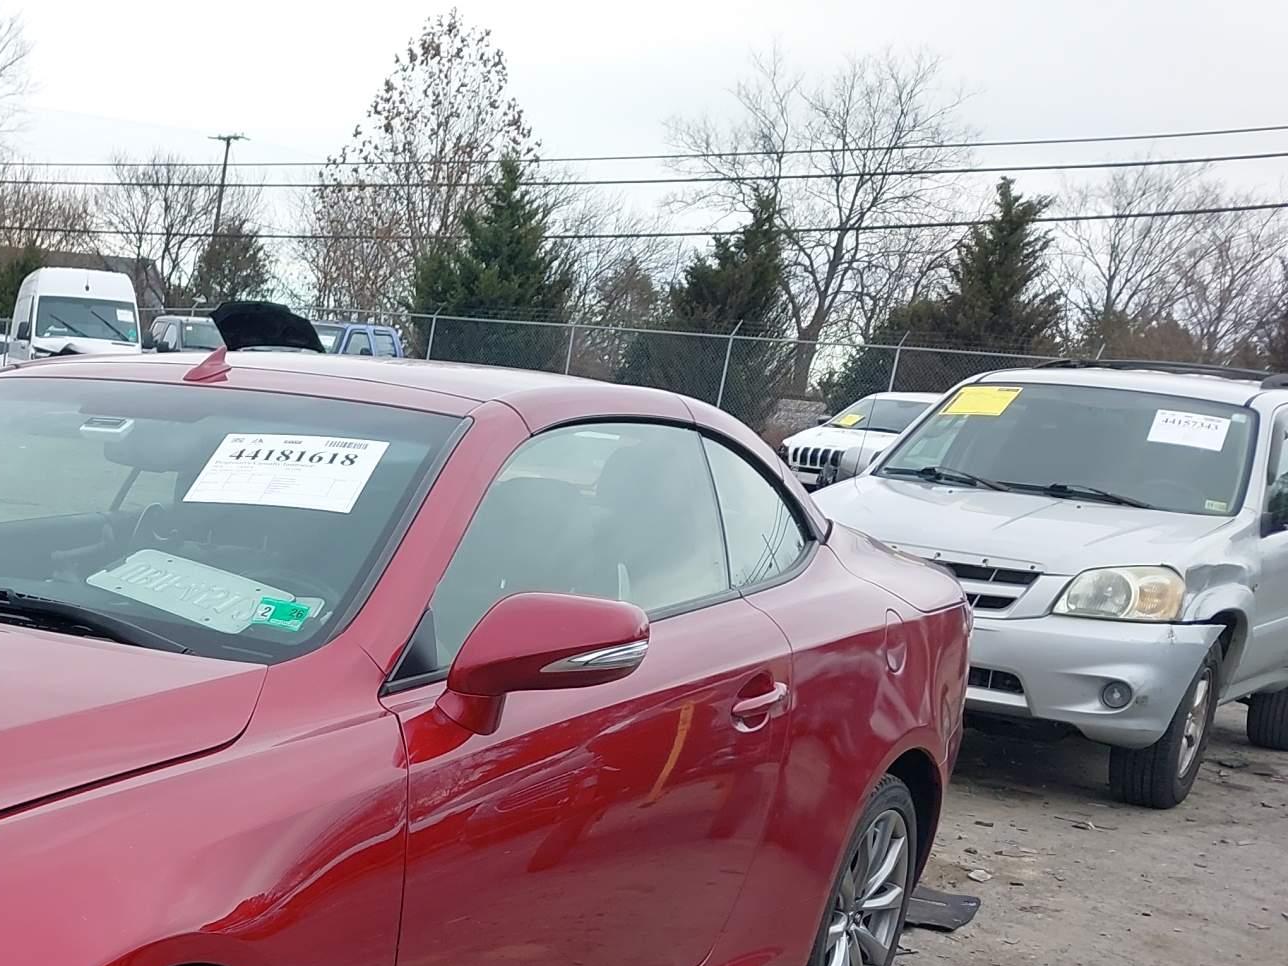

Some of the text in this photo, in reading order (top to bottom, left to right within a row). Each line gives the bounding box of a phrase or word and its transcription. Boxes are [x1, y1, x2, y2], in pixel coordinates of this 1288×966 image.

[228, 448, 359, 467] 44181618
[260, 606, 272, 618] 2
[289, 608, 305, 619] 26
